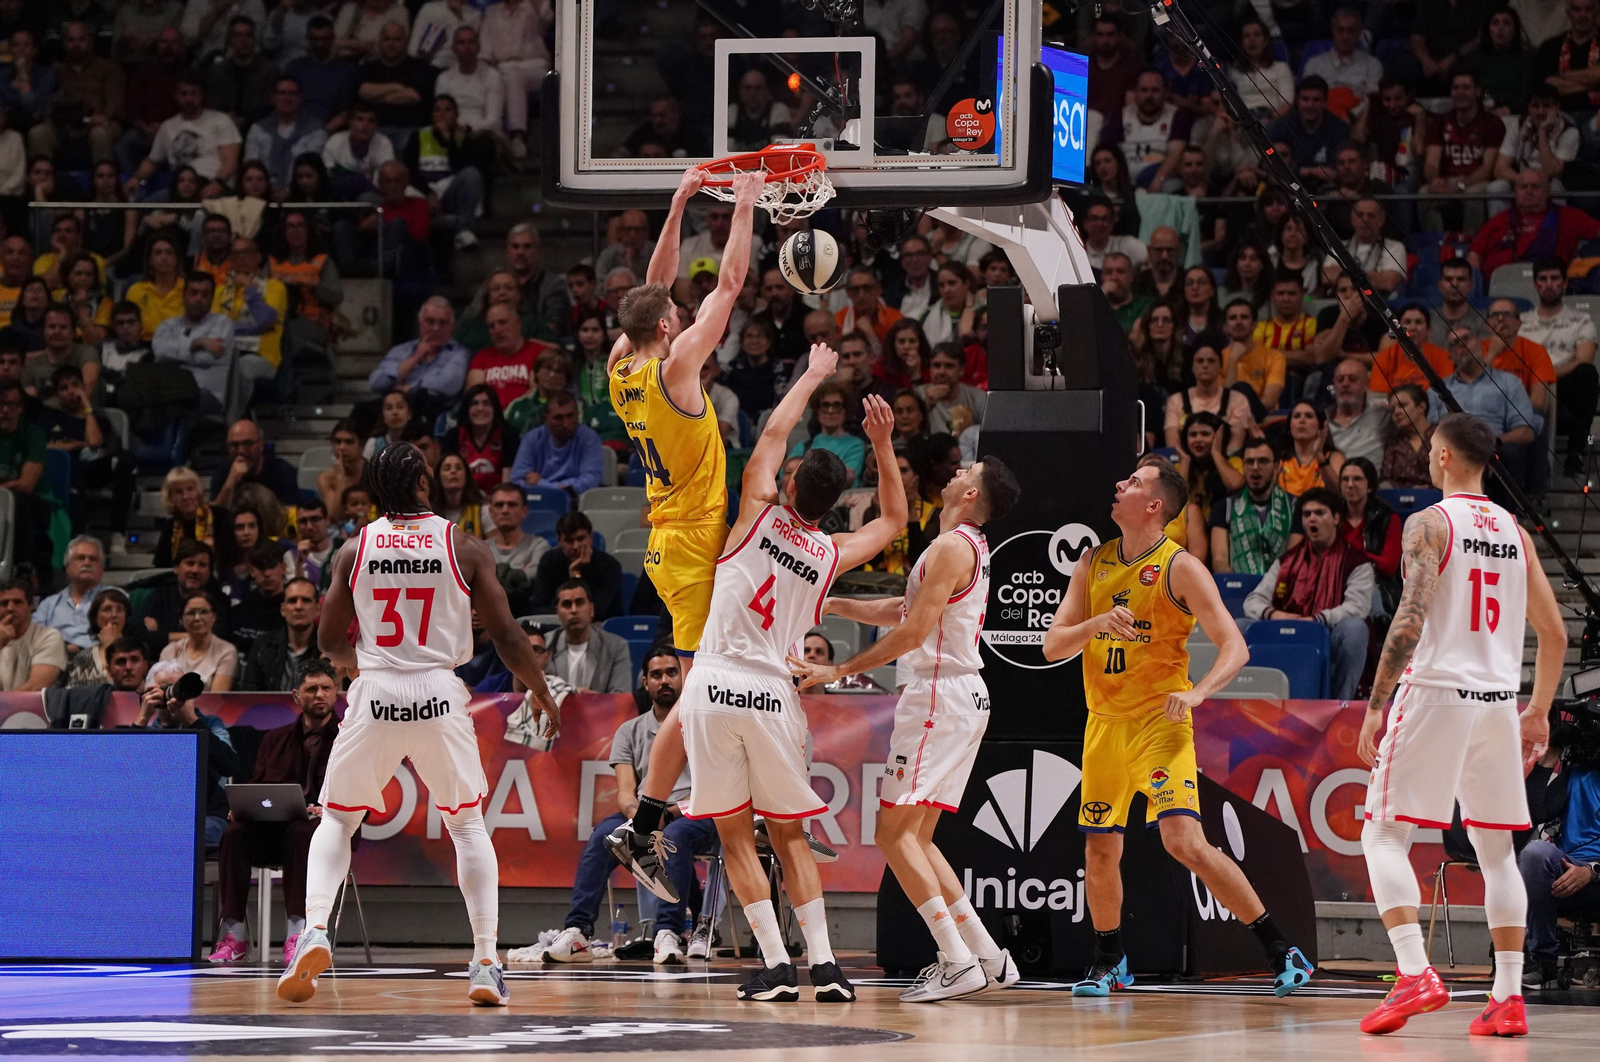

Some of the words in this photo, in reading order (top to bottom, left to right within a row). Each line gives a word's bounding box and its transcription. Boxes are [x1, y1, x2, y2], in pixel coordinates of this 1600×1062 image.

[954, 118, 980, 128] Copa
[966, 128, 983, 137] Rey
[376, 534, 433, 549] OJELEYE
[771, 517, 826, 561] PRADILLA
[368, 559, 442, 575] PAMESA
[759, 536, 819, 585] PAMESA
[1011, 570, 1045, 584] acb
[748, 573, 777, 631] 4
[997, 584, 1061, 608] Copa
[1467, 568, 1501, 635] 15
[372, 587, 435, 648] 37
[1000, 607, 1023, 620] del
[991, 633, 1042, 644] Málaga'24
[1104, 647, 1126, 675] 10
[370, 696, 450, 722] Vitaldin
[708, 684, 782, 713] Vitaldin
